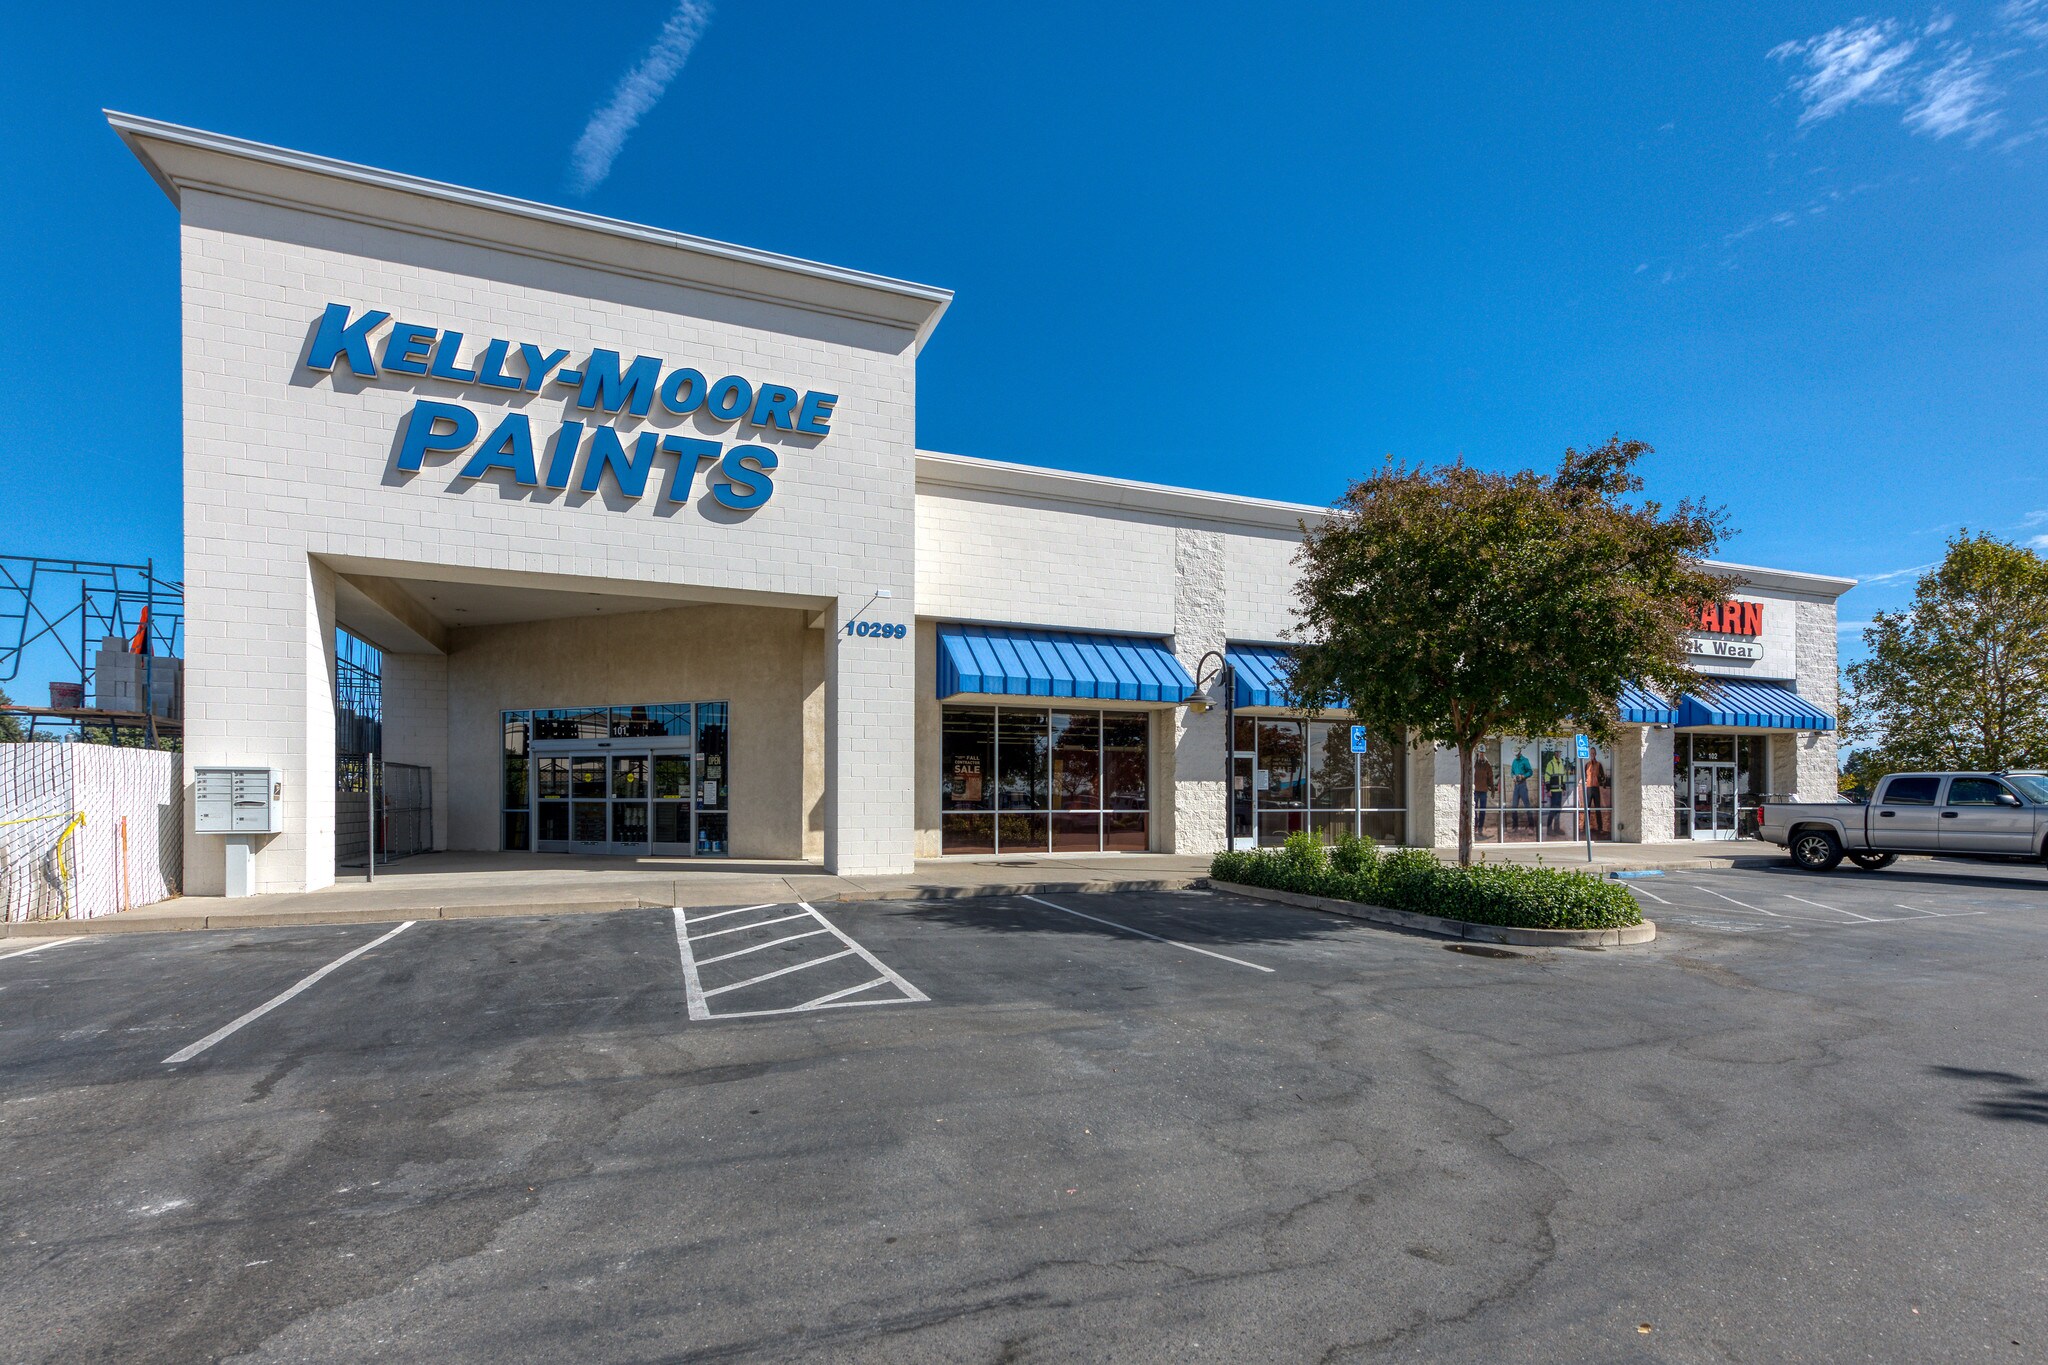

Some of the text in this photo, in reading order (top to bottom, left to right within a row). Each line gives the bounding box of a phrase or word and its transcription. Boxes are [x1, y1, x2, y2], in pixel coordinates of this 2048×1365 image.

[306, 302, 840, 437] KELLY-MOORE
[396, 399, 780, 511] PAINTS
[845, 620, 907, 640] 10299
[1712, 641, 1753, 657] Wear
[612, 726, 627, 736] 101
[954, 765, 980, 773] SALE
